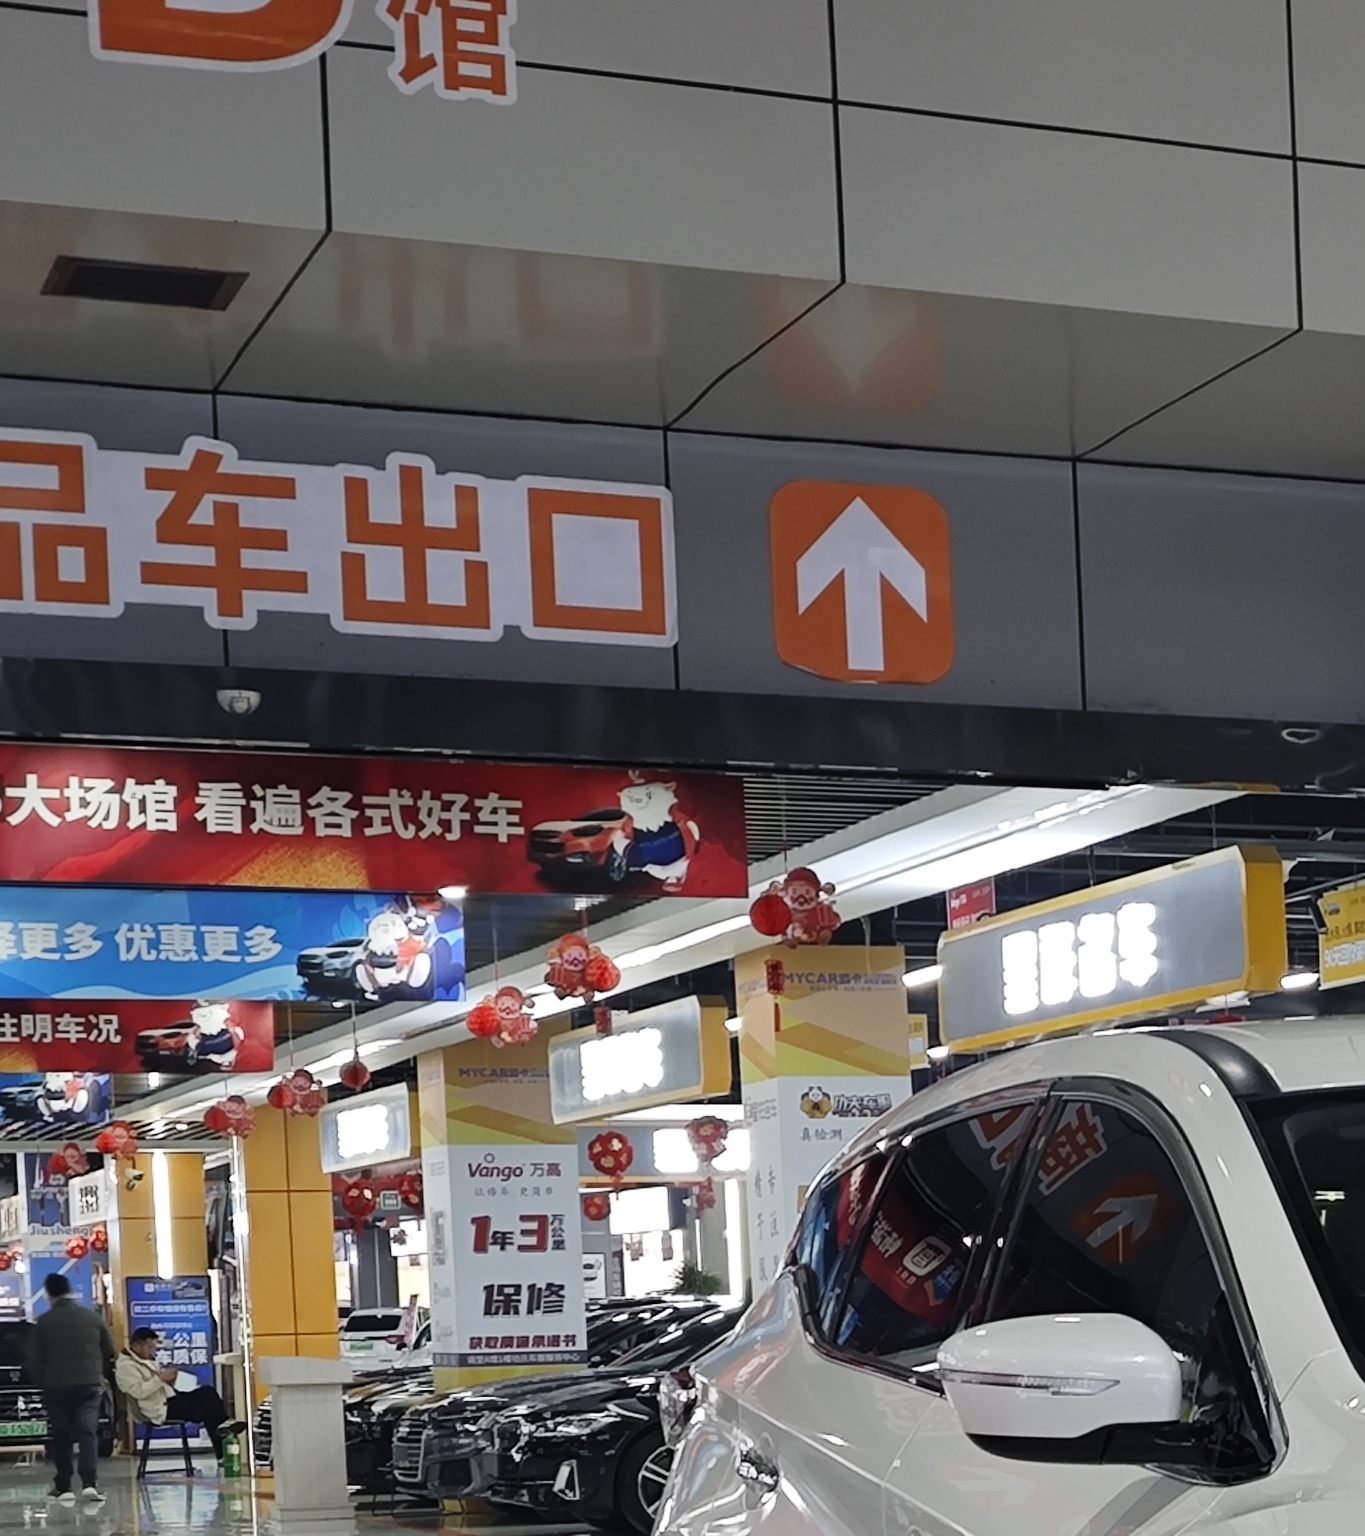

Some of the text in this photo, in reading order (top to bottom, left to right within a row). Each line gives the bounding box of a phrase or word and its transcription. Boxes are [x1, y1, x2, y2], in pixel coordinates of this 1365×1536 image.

[0, 438, 667, 636] 品车出口
[5, 774, 525, 842] 大场馆 看遍各式好车
[115, 922, 283, 963] 优惠更多
[468, 1162, 562, 1182] Vango 万高
[483, 1282, 566, 1316] 保修
